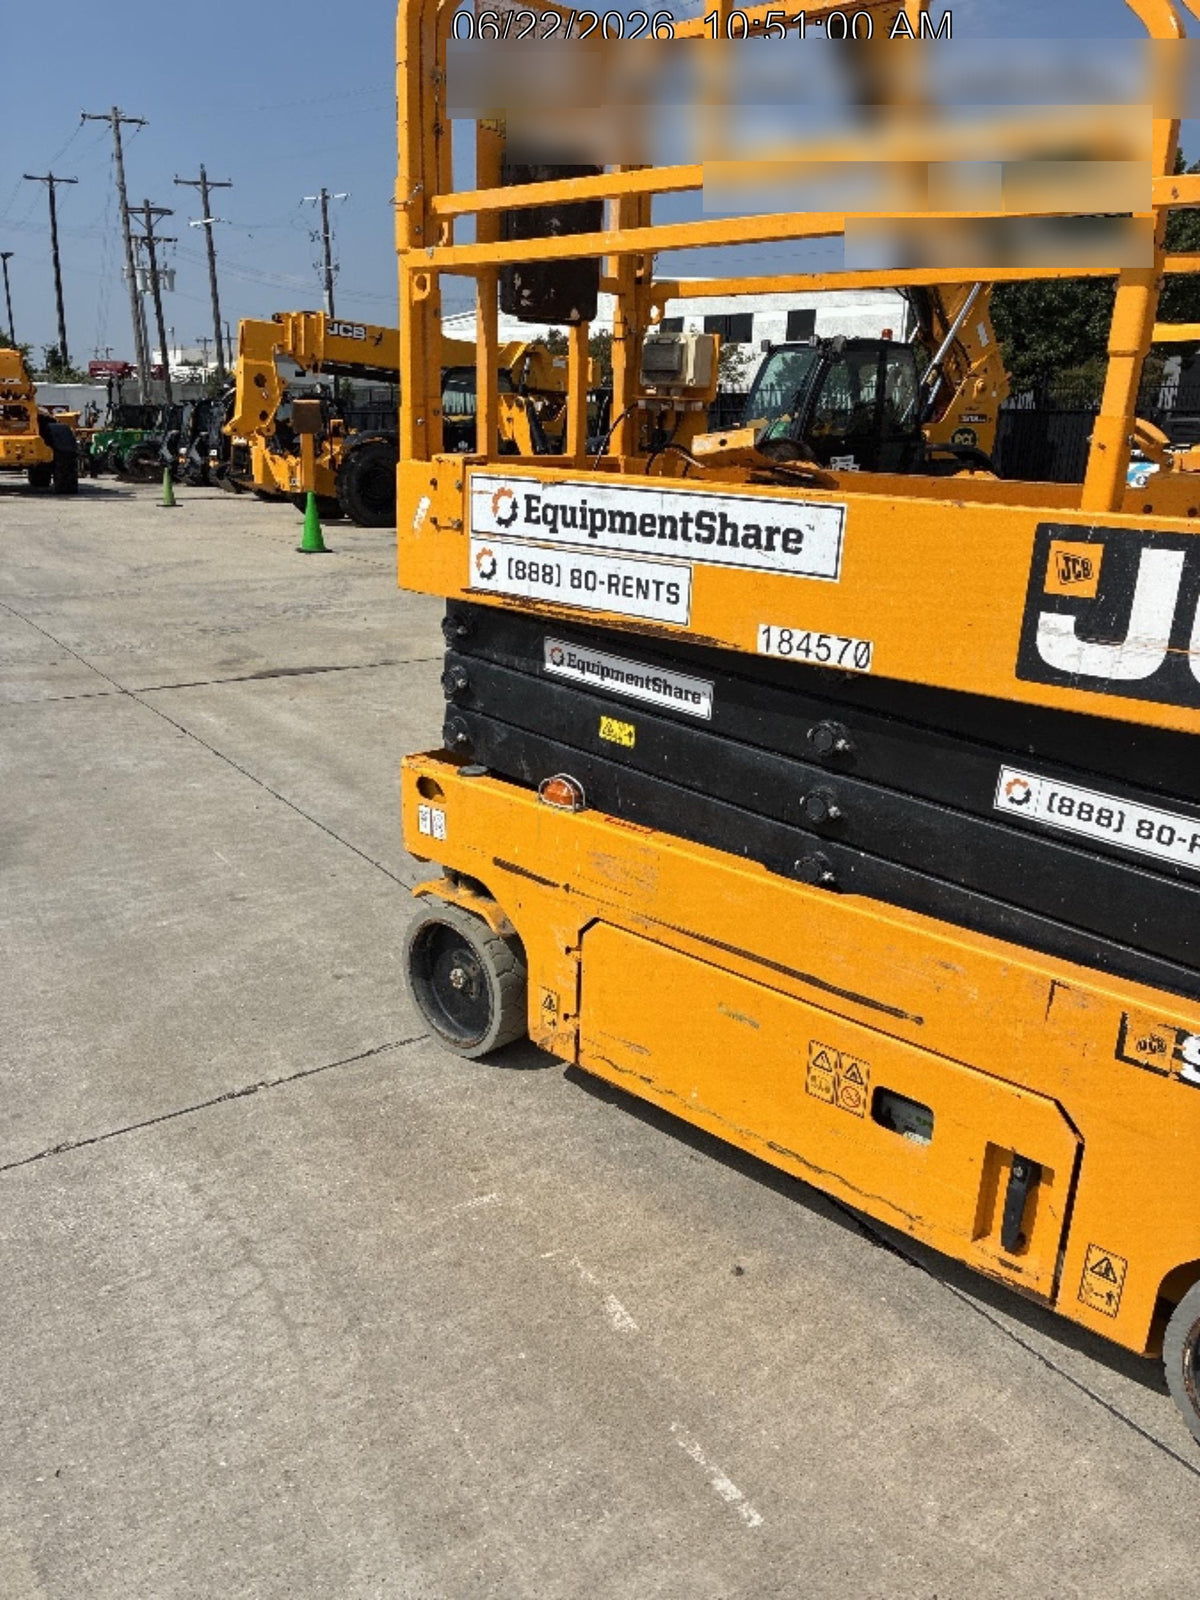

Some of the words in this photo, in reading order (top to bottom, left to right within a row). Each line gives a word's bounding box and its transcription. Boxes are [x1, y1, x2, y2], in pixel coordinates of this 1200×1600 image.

[326, 322, 366, 341] JCB
[523, 493, 803, 555] EquipmentShare
[507, 558, 561, 588] (888)
[570, 567, 681, 605] 80-RENTS
[1060, 554, 1092, 582] JCB
[1036, 547, 1200, 681] J
[761, 626, 871, 669] 184570
[566, 651, 702, 705] EquipmentShare
[1046, 791, 1126, 833] (888)
